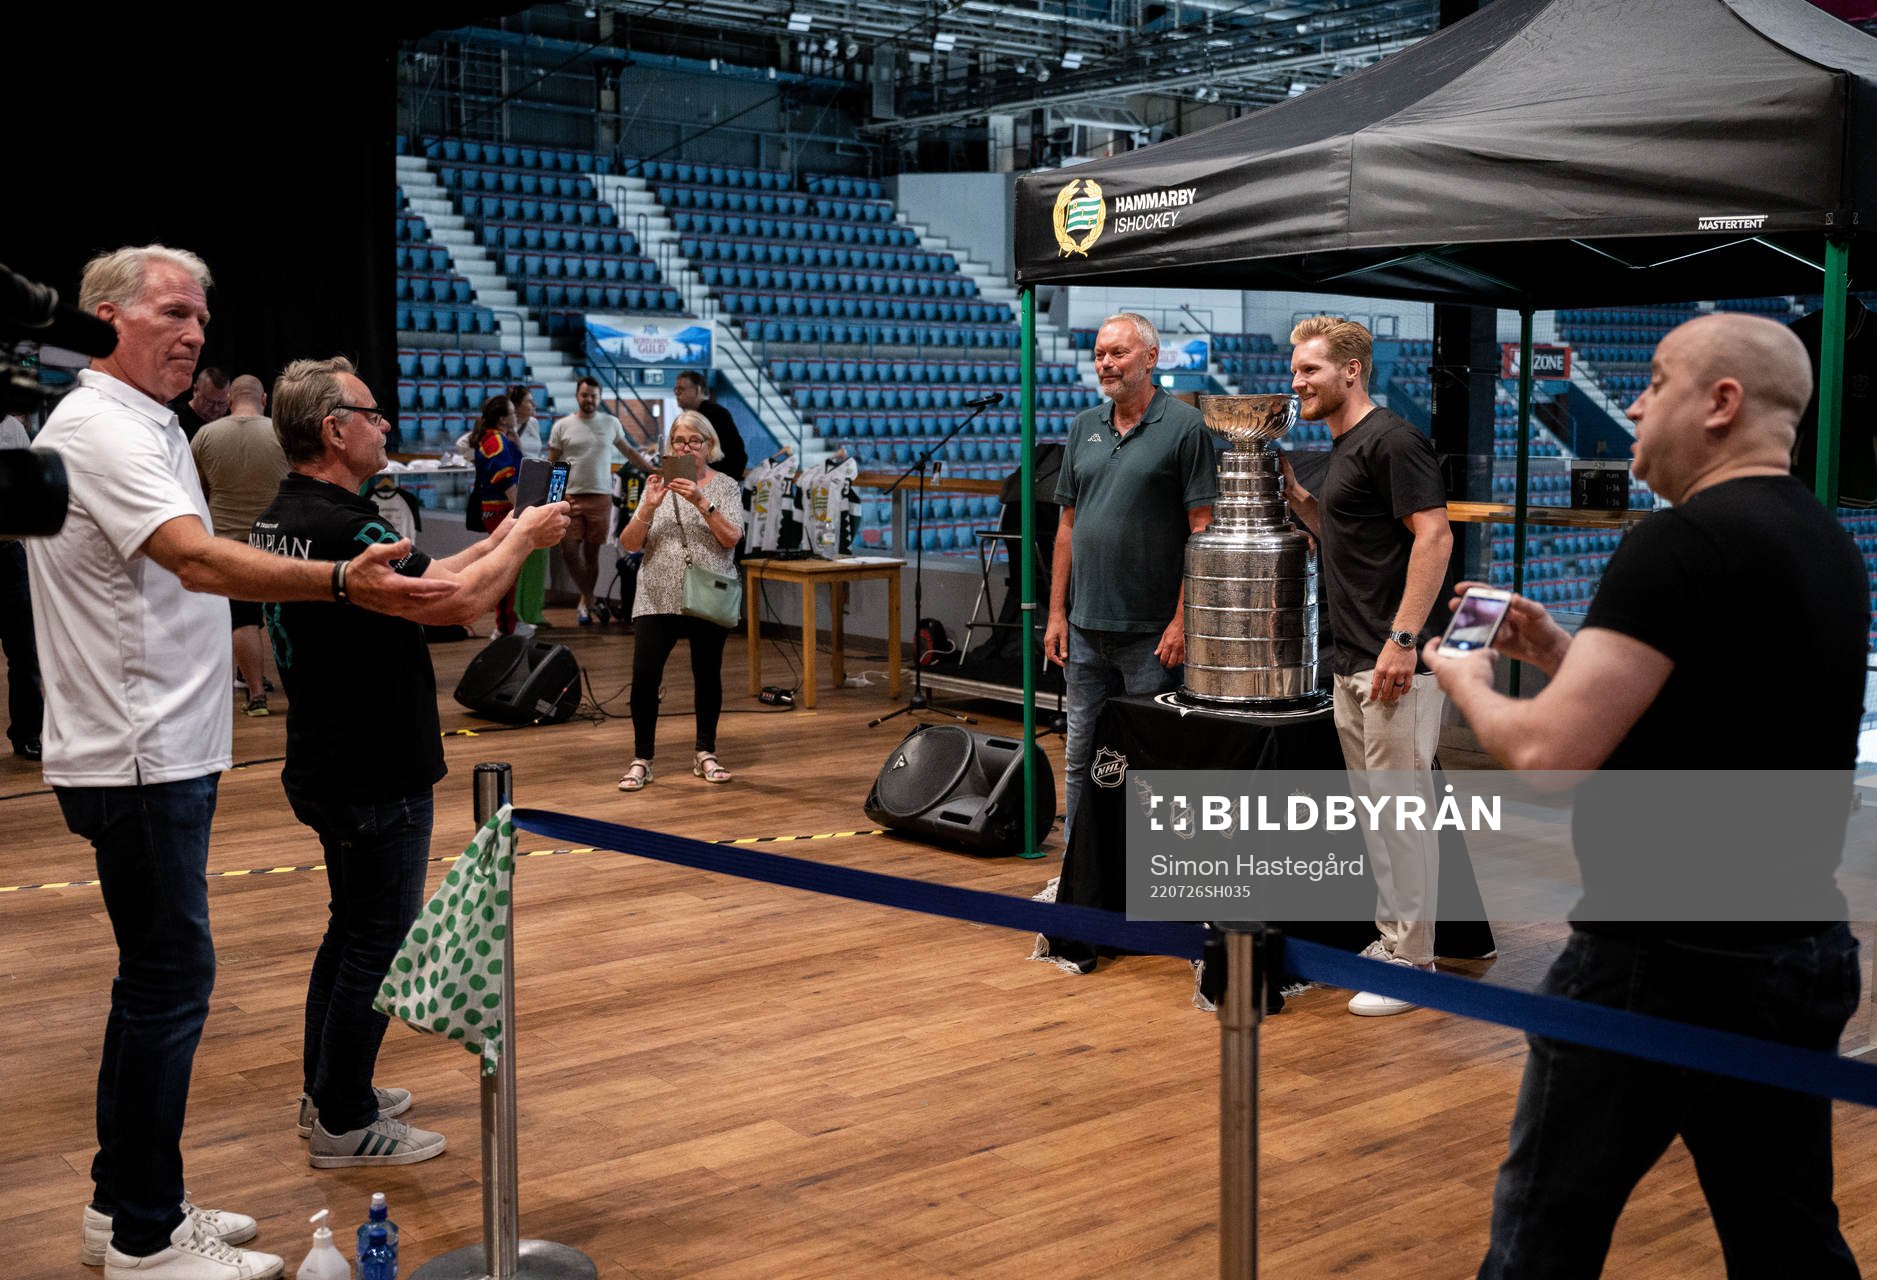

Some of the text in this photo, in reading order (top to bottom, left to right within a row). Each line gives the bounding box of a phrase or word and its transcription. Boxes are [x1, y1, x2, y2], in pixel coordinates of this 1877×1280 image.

[1115, 188, 1197, 213] HAMMARBY
[1114, 211, 1181, 234] ISHOCKEY
[1698, 218, 1765, 230] MASTERTENT
[638, 343, 666, 354] GULD
[1533, 353, 1565, 371] ZONE
[1096, 762, 1120, 777] NHL
